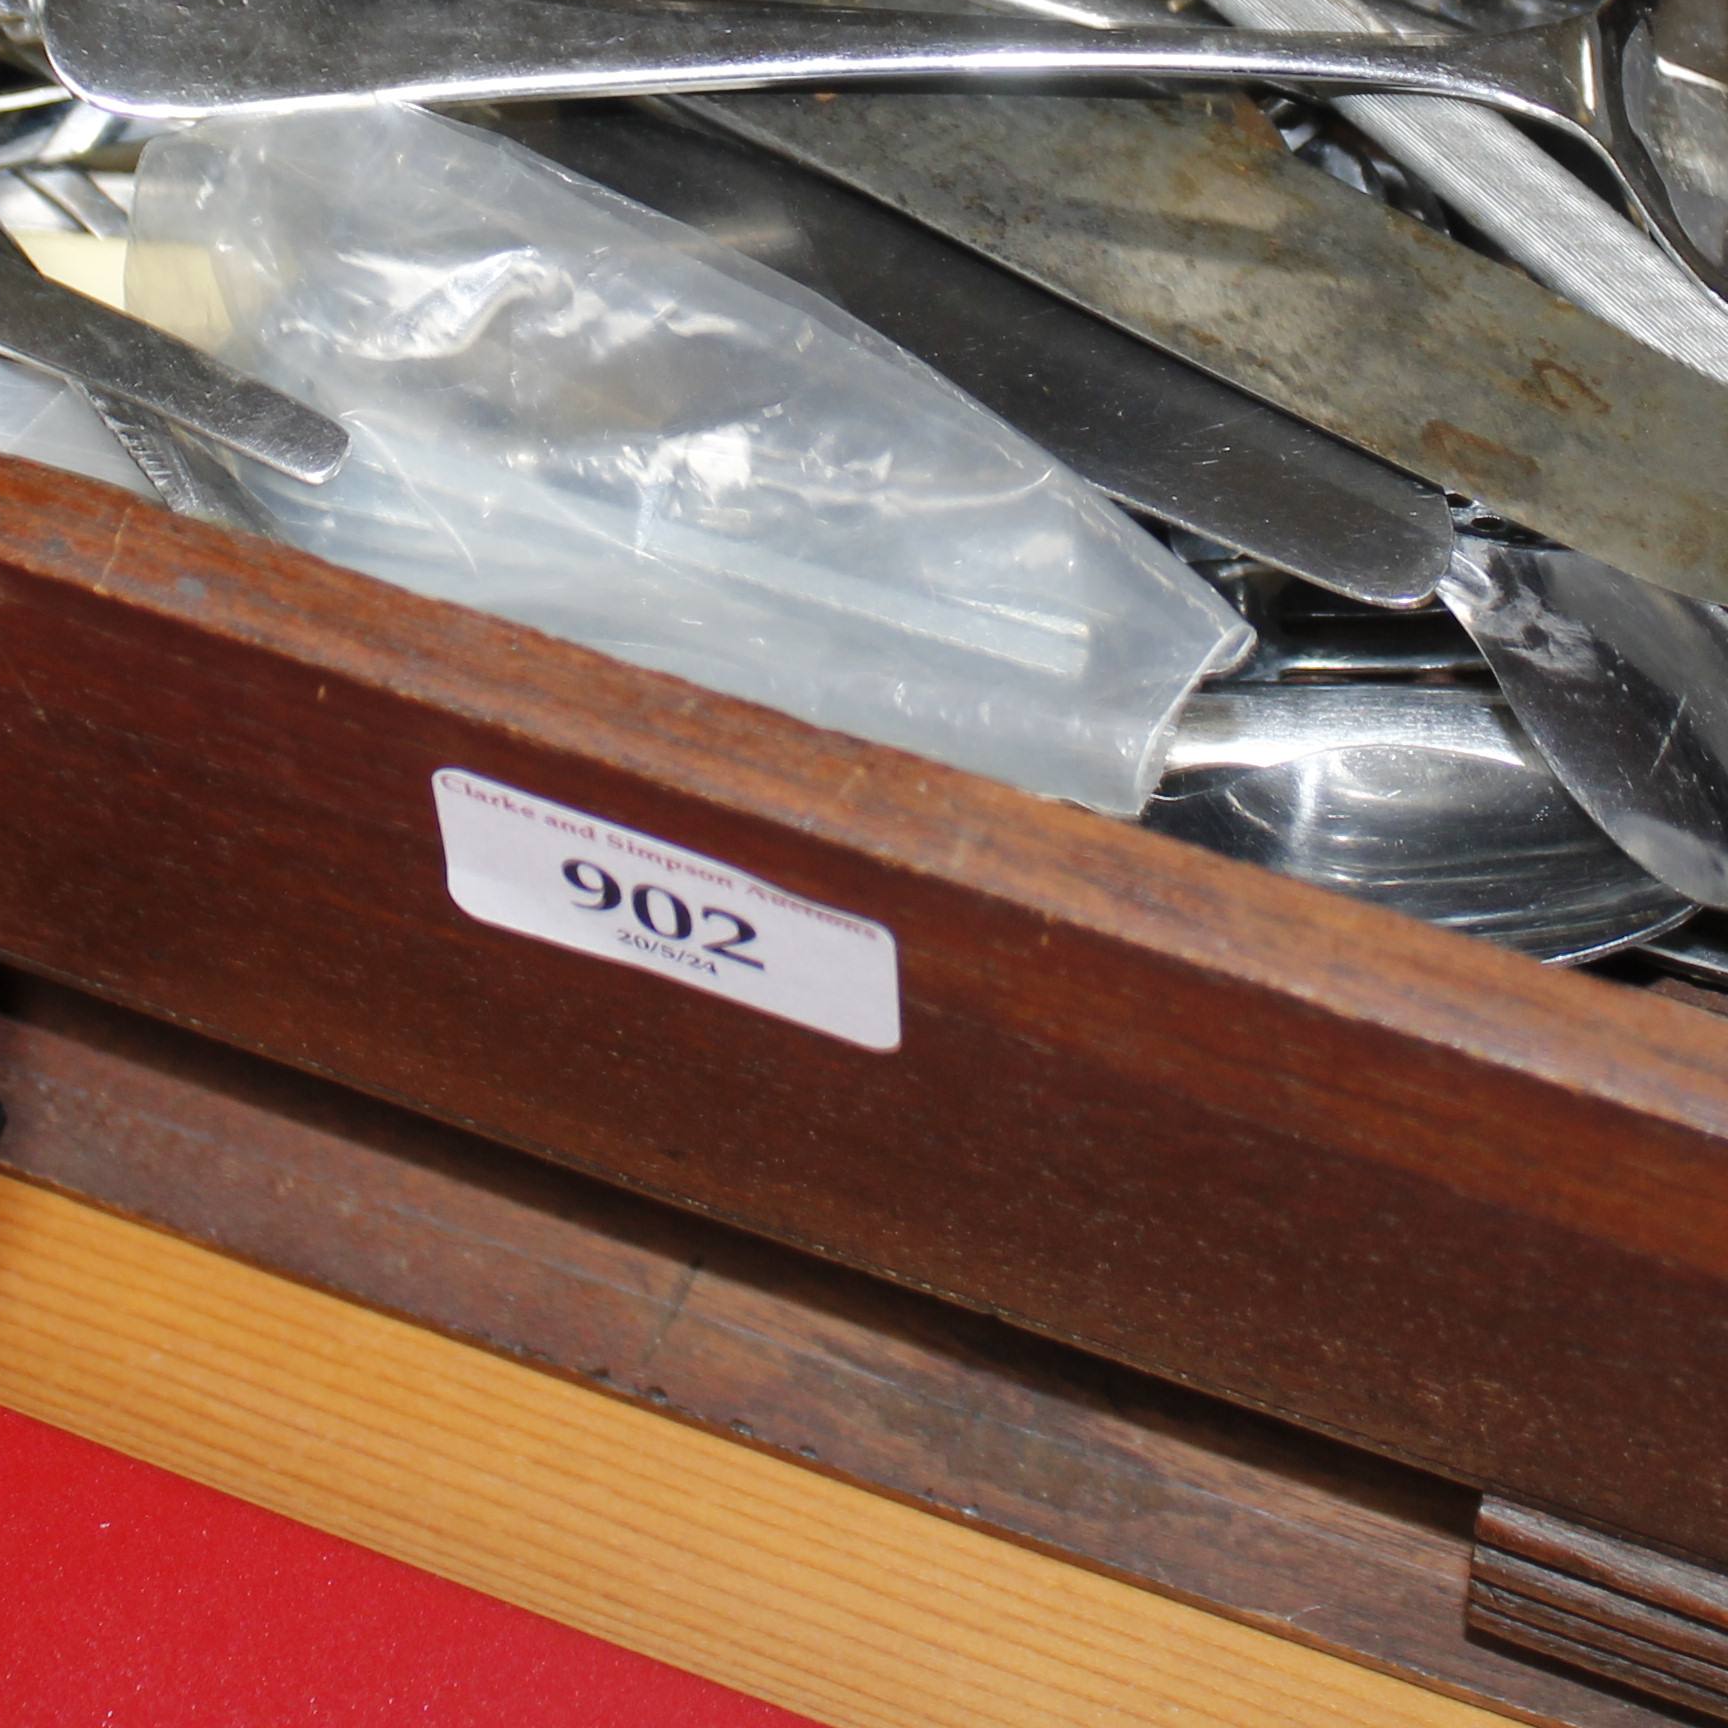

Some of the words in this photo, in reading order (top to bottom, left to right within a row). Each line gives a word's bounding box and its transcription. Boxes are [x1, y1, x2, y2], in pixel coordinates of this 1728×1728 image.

[440, 774, 536, 820] Clarke
[543, 813, 597, 842] and
[606, 831, 733, 890] Simpson
[561, 858, 766, 971] 902
[616, 928, 719, 975] 20/5/24
